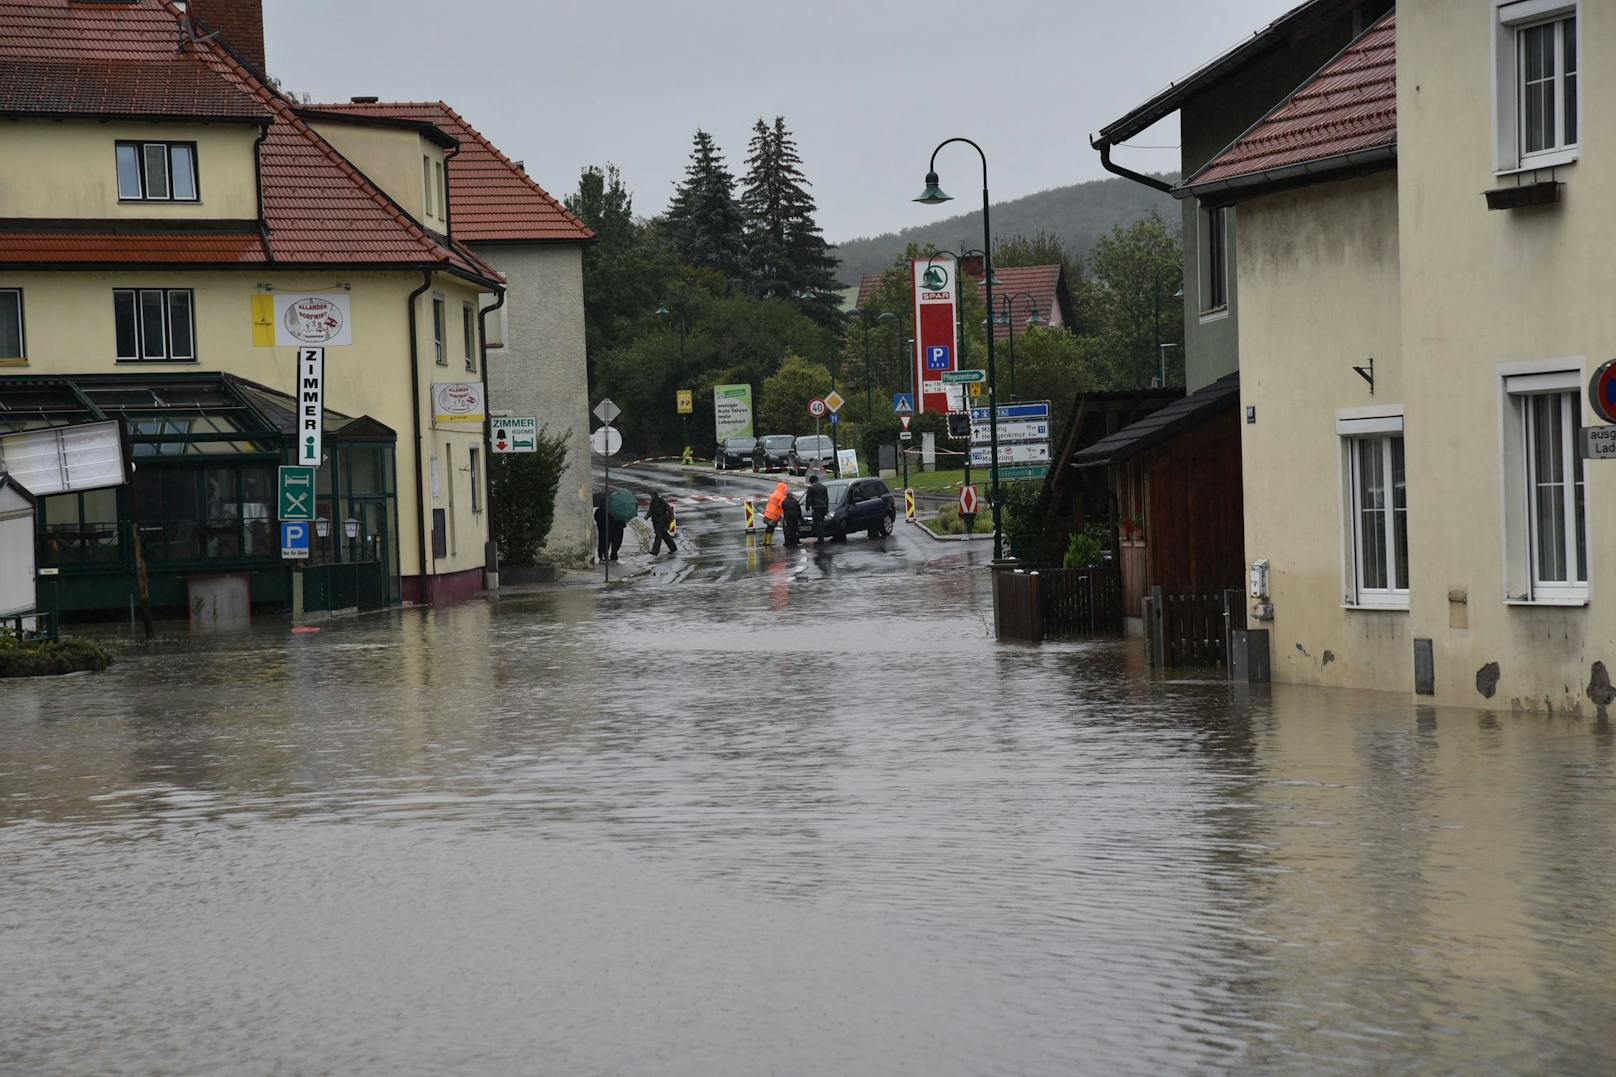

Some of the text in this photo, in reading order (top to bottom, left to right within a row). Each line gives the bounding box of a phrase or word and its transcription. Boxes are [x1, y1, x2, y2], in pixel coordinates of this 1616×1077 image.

[933, 348, 944, 362] P
[303, 351, 318, 430] ZIMMER
[812, 403, 823, 412] 40
[492, 419, 534, 428] ZIMMER
[982, 432, 1025, 440] Hegenkreuz
[287, 526, 304, 547] P
